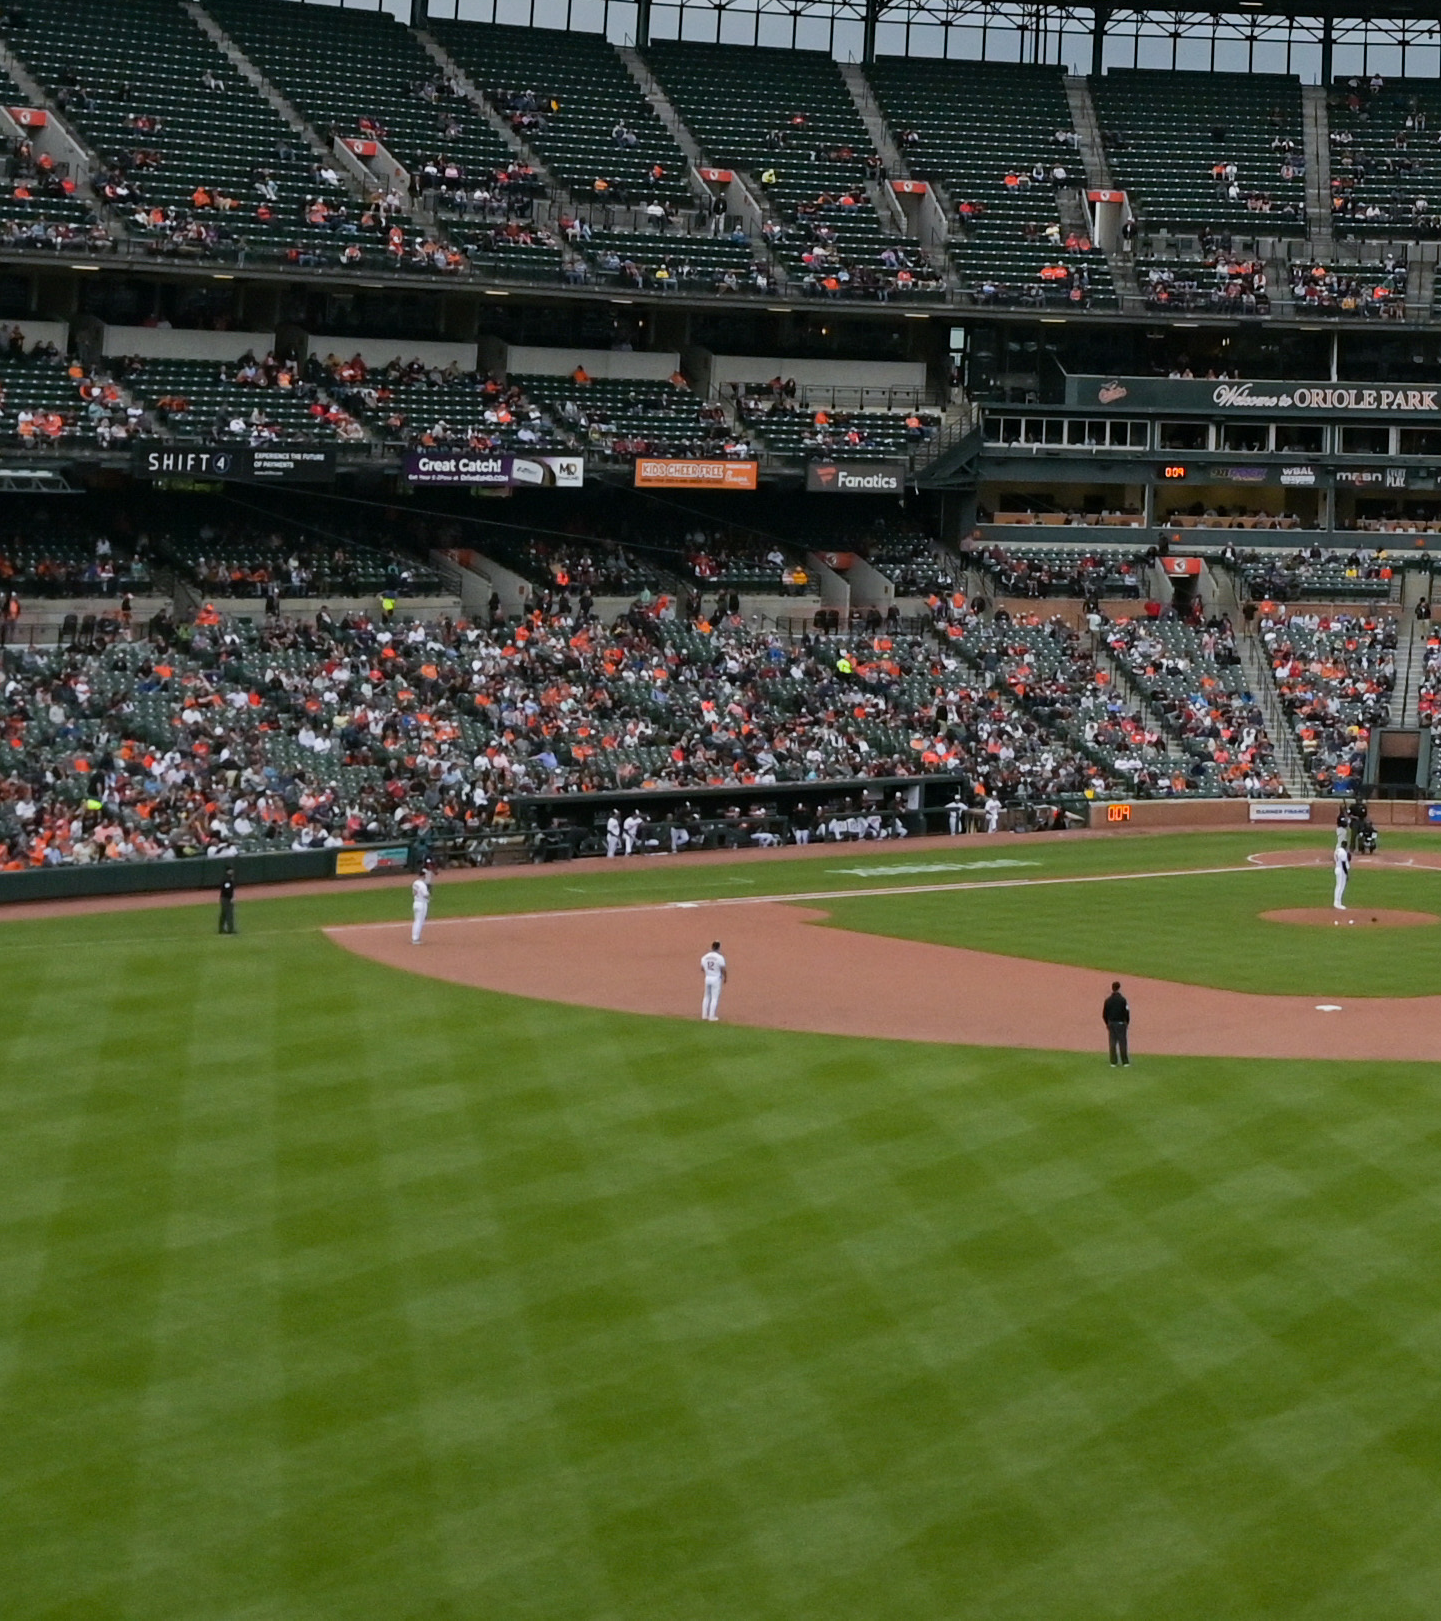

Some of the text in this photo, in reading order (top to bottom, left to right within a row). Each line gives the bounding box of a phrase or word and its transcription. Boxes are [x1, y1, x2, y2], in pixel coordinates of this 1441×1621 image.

[1213, 383, 1277, 407] Welcome
[1278, 393, 1292, 407] to
[1294, 389, 1377, 409] ORIOLE
[1380, 391, 1438, 411] PARK
[148, 453, 211, 471] SHIFT
[418, 458, 502, 472] Great Catch!
[642, 463, 666, 476] KIDS
[666, 463, 699, 477] CHEER
[699, 464, 724, 478] FREE
[1282, 467, 1314, 475] WBAL
[837, 471, 897, 488] Fanatics
